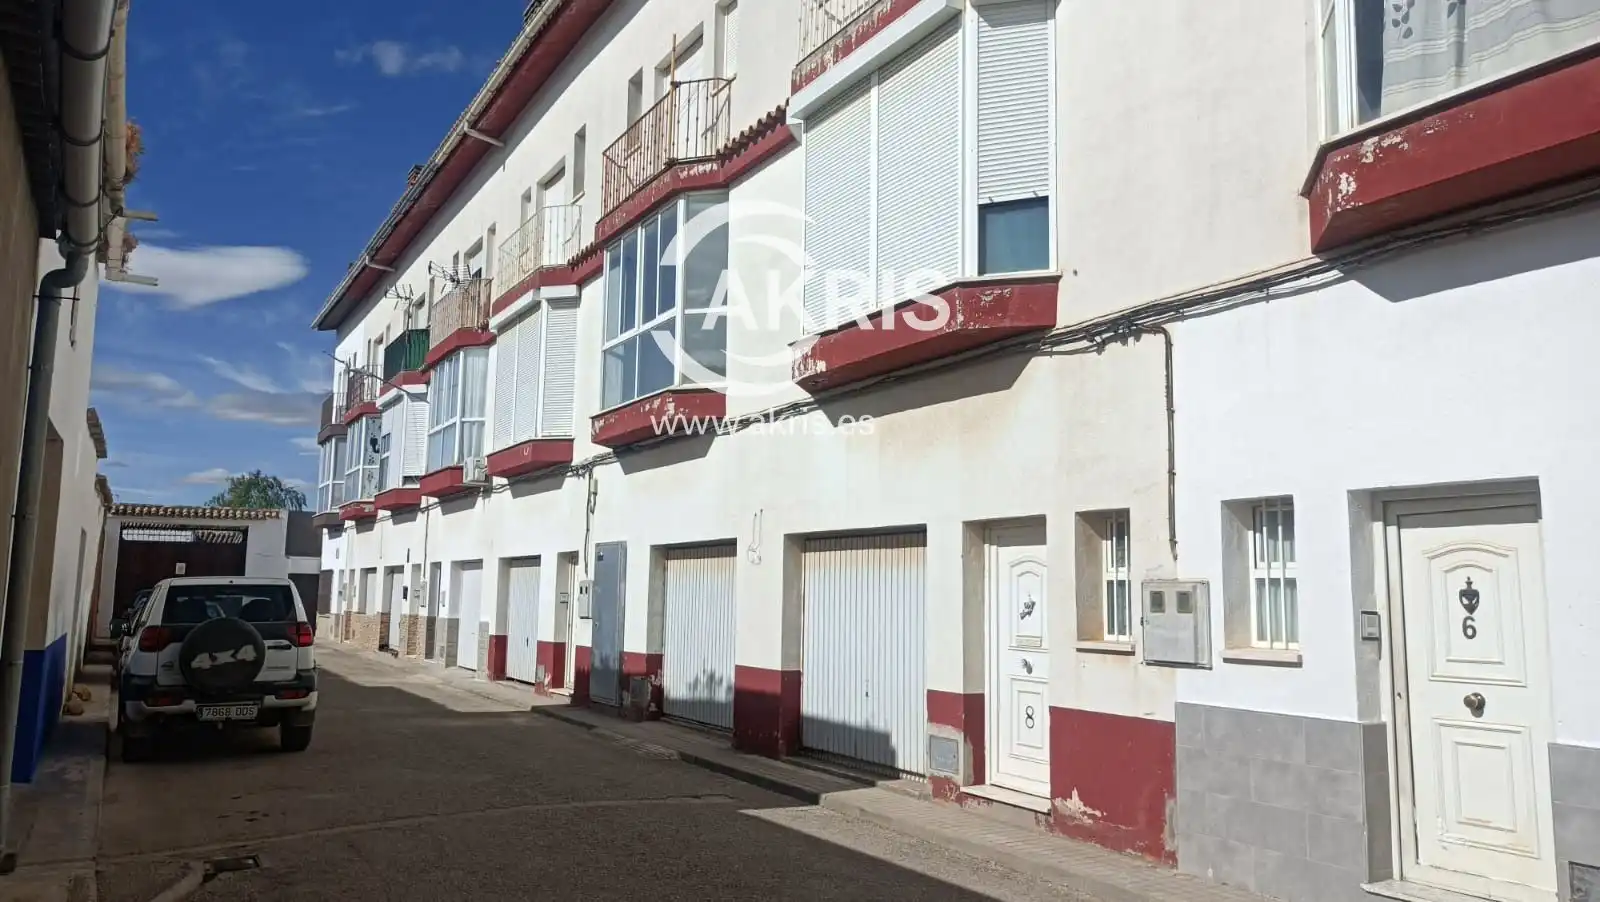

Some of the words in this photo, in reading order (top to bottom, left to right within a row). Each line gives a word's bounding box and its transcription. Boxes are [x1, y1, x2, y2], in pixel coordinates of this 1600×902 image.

[1462, 615, 1477, 640] 6
[204, 707, 232, 717] 7868
[1025, 705, 1035, 729] 8
